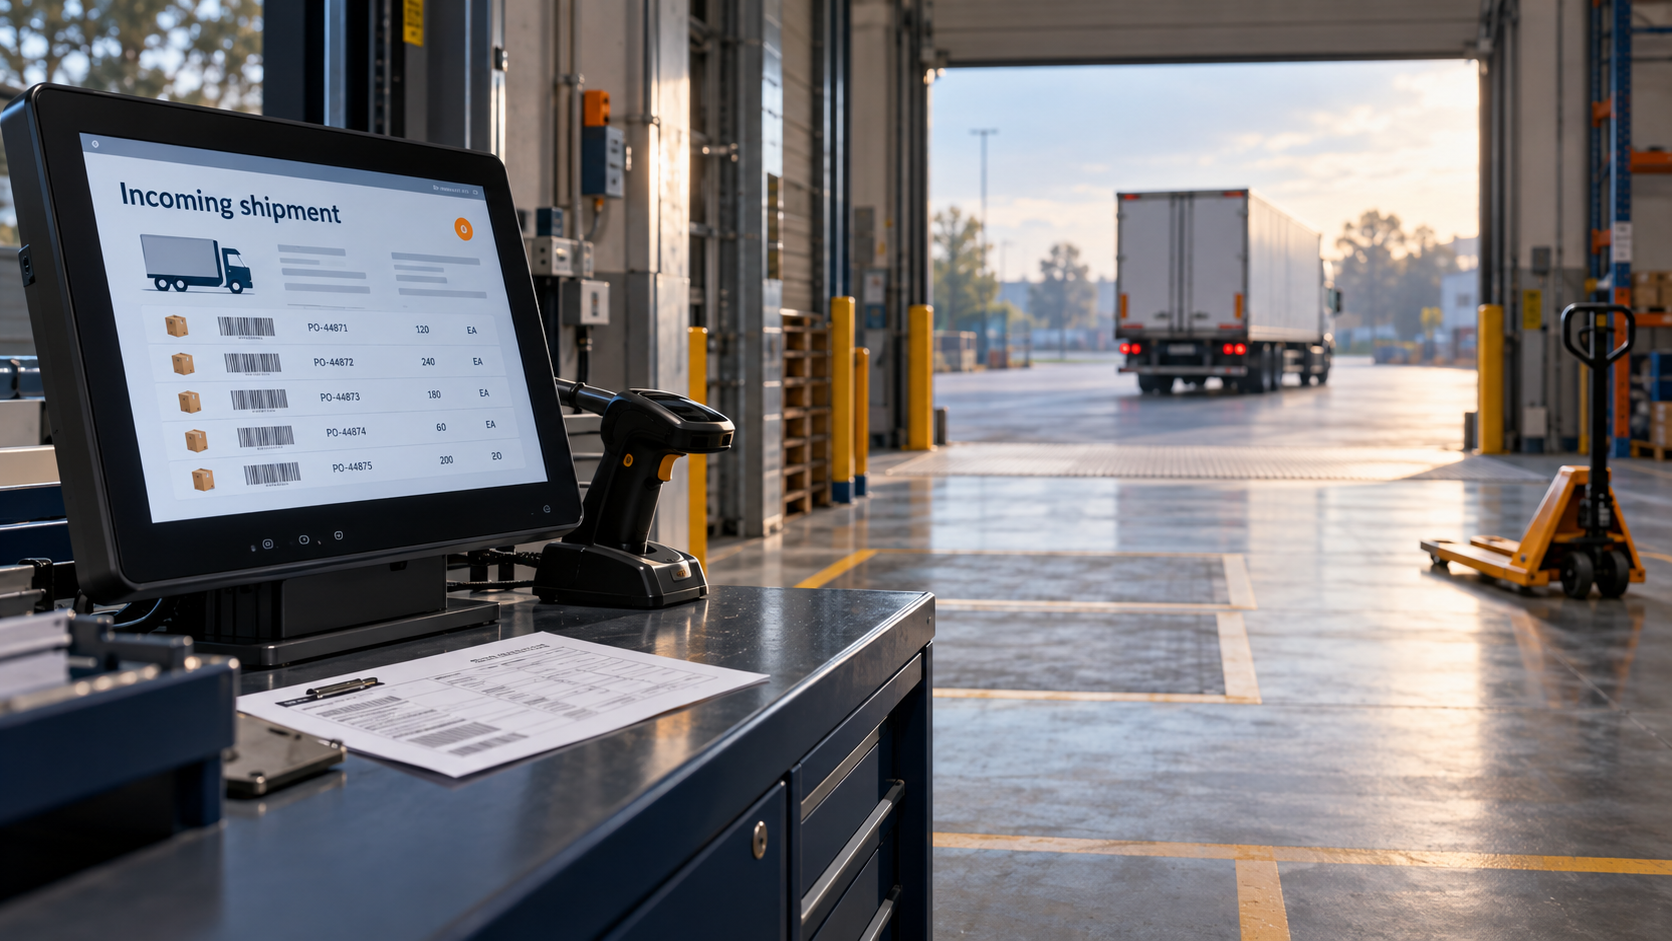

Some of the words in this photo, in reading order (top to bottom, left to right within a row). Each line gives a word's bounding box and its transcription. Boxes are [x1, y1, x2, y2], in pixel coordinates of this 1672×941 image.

[120, 182, 234, 219] Incoming
[240, 195, 341, 223] shipment
[308, 323, 347, 332] PO-44871
[416, 325, 429, 333] 120
[467, 326, 477, 334] EA
[314, 358, 354, 366] PO-44872
[422, 358, 435, 366] 240
[320, 392, 360, 401] PO-44873
[428, 390, 441, 398] 180
[479, 389, 489, 397] EA
[327, 427, 366, 437] PO-44874
[437, 423, 446, 431] 60
[333, 461, 372, 472] PO-44875
[440, 455, 453, 464] 200
[491, 452, 502, 460] 20
